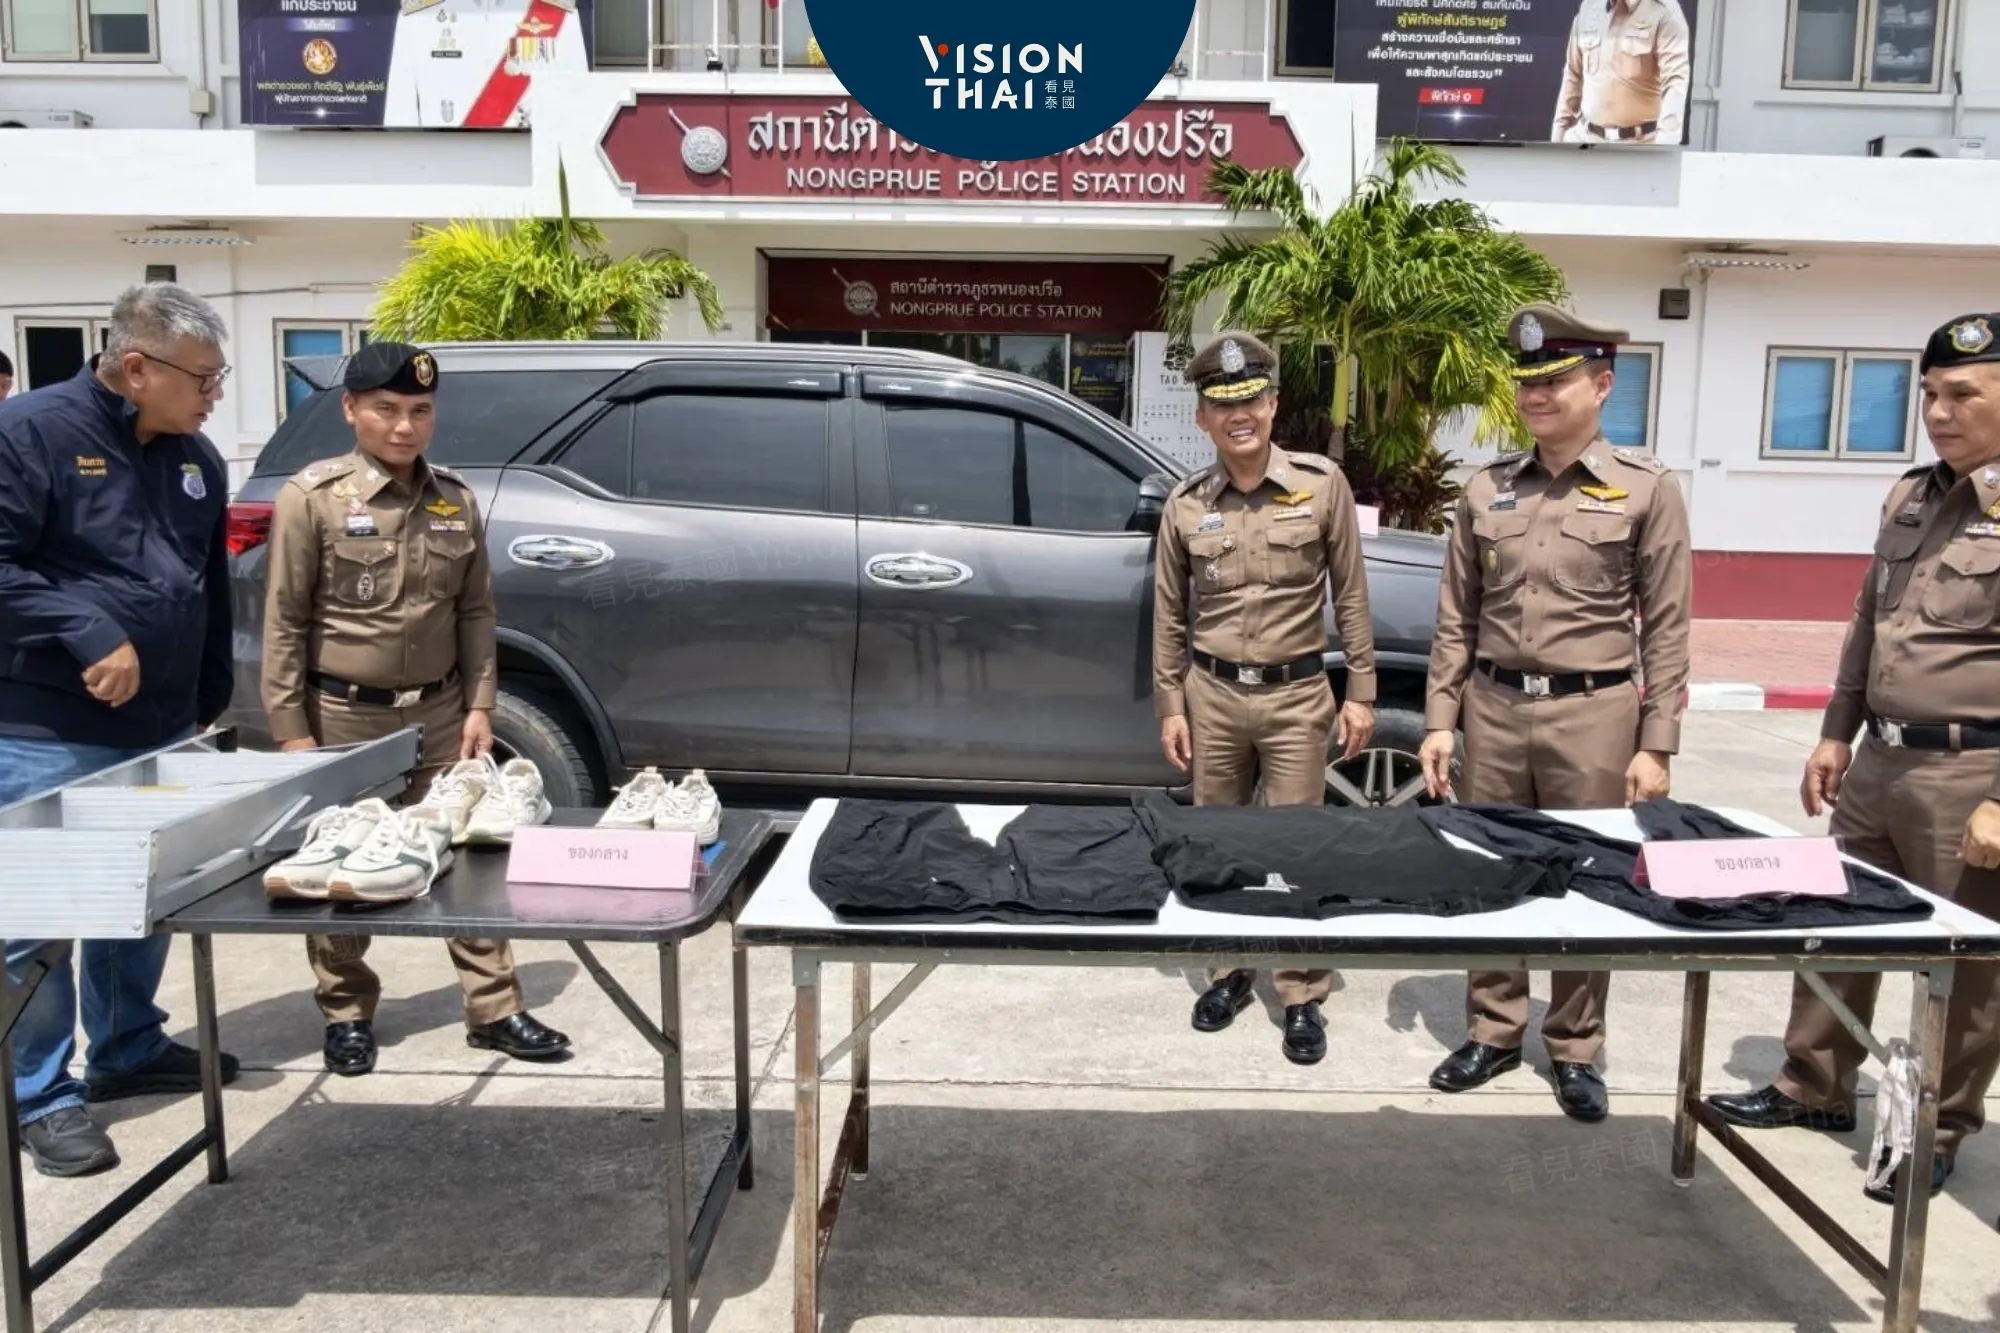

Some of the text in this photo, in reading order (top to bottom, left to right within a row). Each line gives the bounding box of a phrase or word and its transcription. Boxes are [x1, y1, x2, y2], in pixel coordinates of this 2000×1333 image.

[786, 167, 1186, 196] NONGPRUE POLICE STATION
[890, 277, 1062, 300] สถานีตำรวจภูธรหนองปรือ
[890, 302, 1103, 319] NONGPRUE POLICE STATION
[567, 847, 629, 861] ของกลาง
[1714, 856, 1781, 871] ของกลาง
